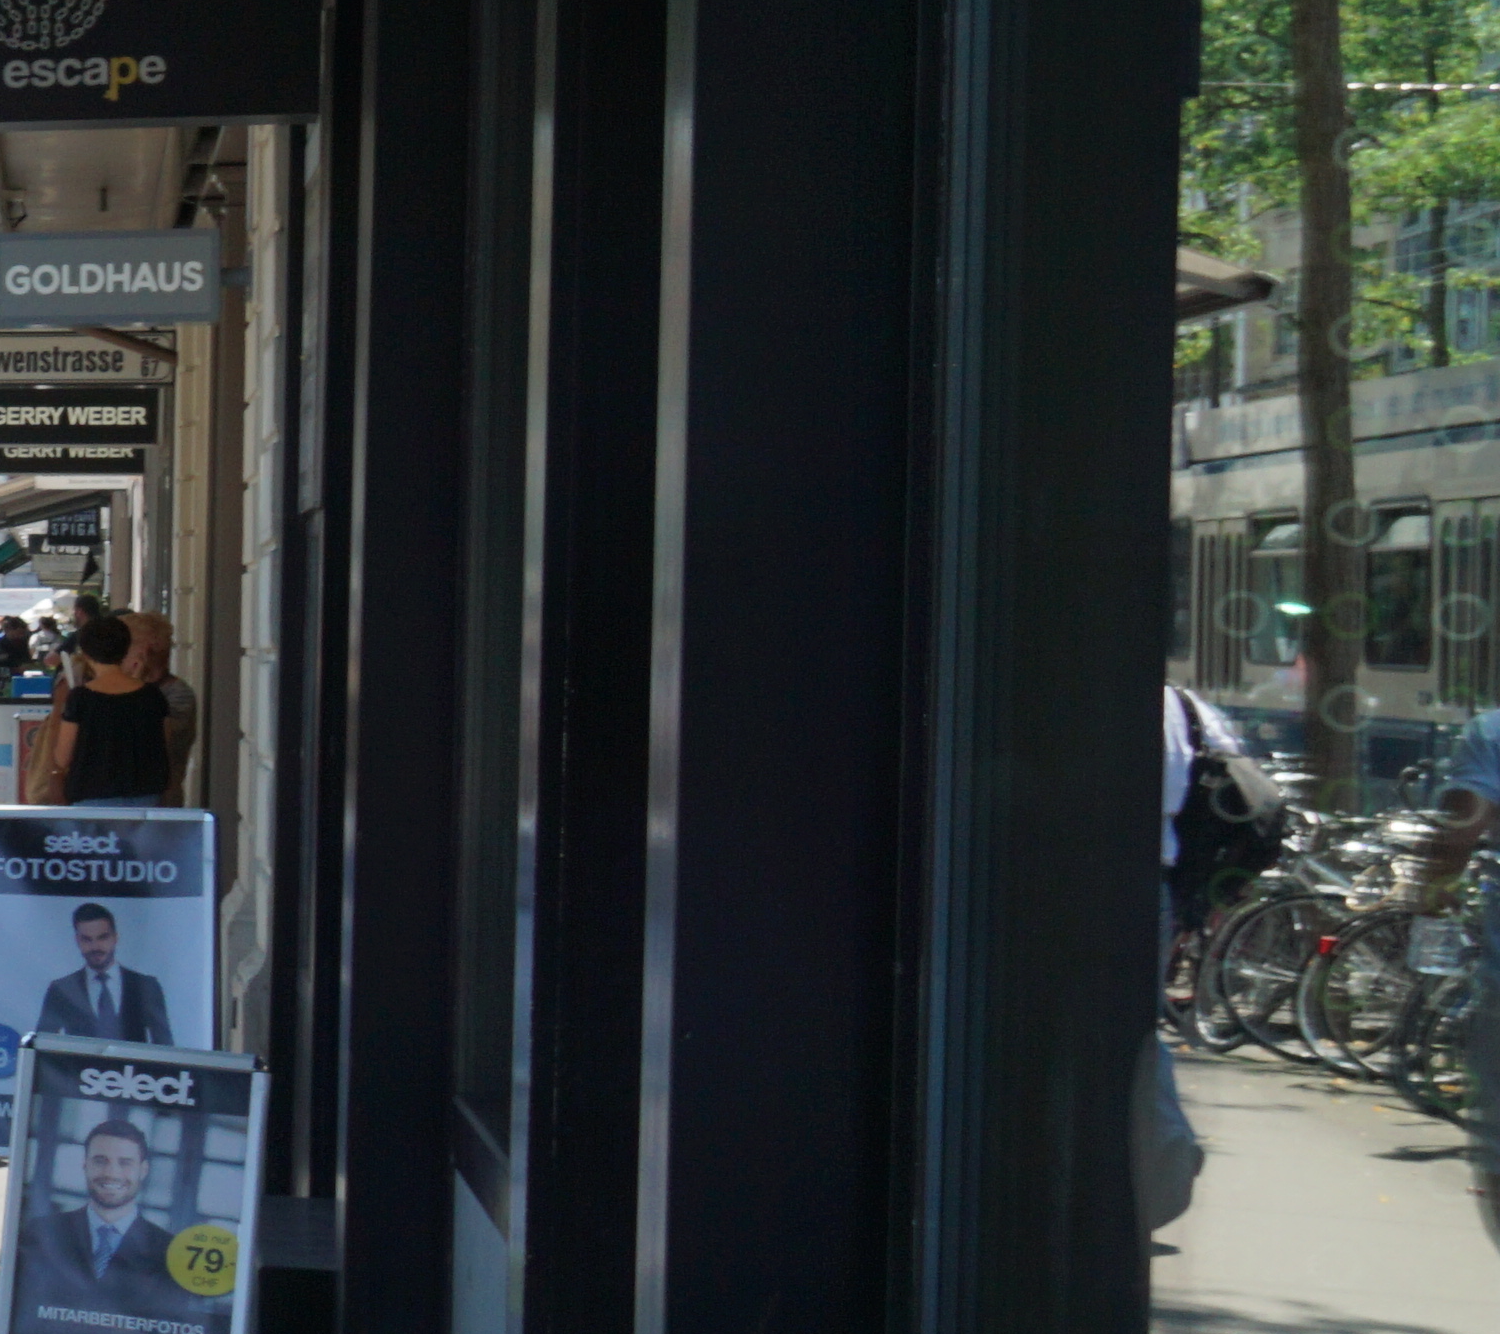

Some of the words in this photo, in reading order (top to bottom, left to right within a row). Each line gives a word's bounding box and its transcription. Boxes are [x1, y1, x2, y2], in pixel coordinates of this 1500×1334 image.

[2, 54, 168, 101] escape
[4, 260, 205, 295] GOLDHAUS
[67, 406, 148, 426] WEBER
[193, 1232, 208, 1244] ab
[211, 1235, 231, 1246] nur
[191, 1275, 220, 1288] CHF
